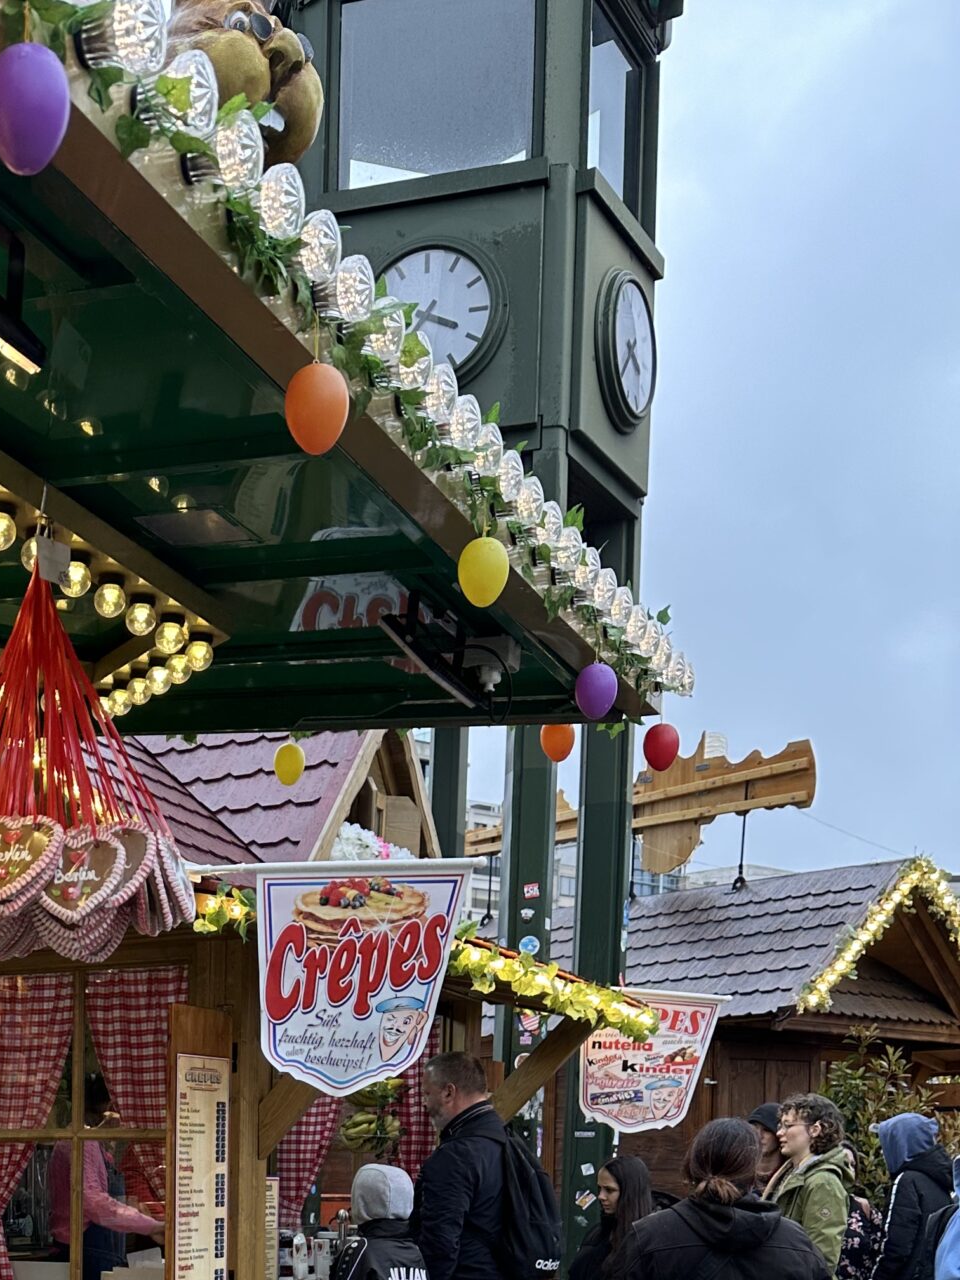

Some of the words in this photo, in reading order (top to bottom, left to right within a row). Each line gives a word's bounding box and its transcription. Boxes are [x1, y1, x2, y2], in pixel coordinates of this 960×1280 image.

[54, 866, 100, 884] Berlin
[264, 914, 448, 1023] Crêpes
[658, 1007, 706, 1035] PES
[328, 1030, 376, 1053] herzhaft
[592, 1040, 653, 1051] nutella
